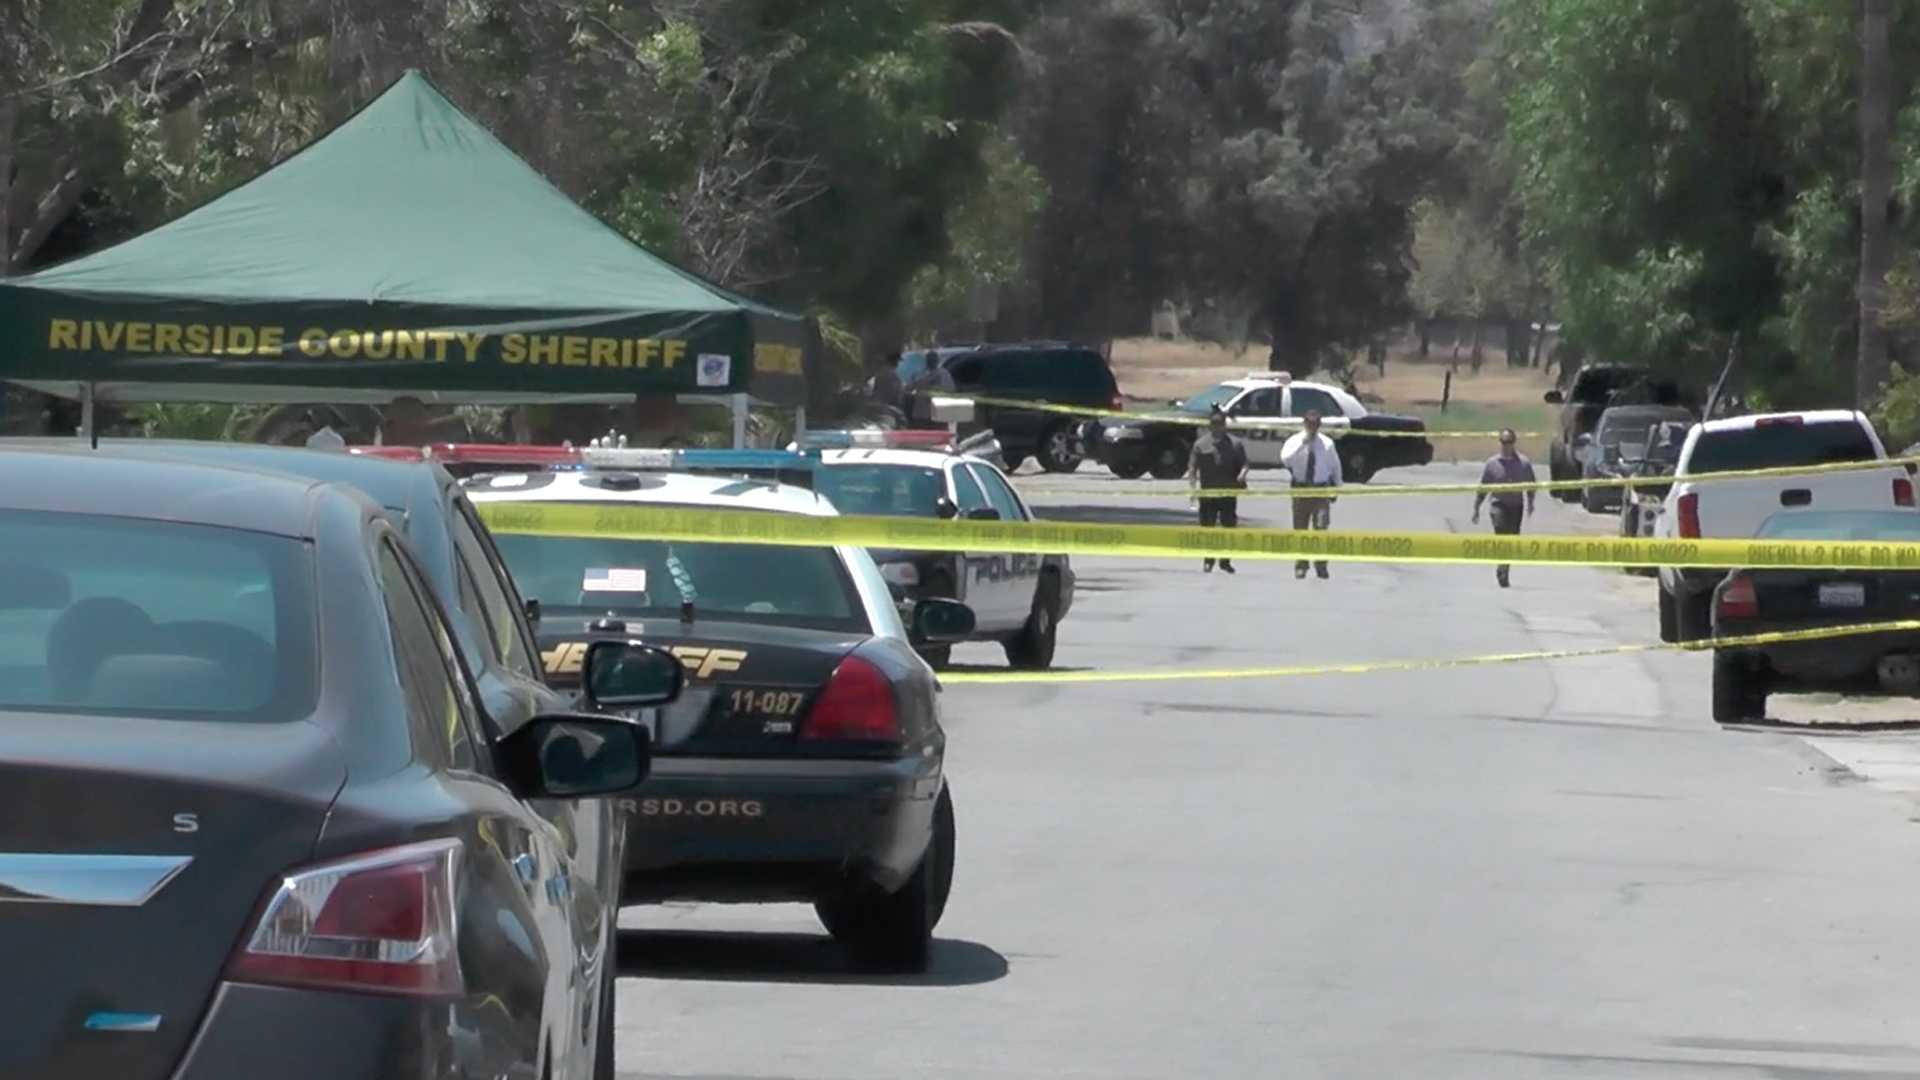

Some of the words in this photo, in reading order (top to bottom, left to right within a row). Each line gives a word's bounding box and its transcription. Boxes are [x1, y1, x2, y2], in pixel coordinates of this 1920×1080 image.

[48, 318, 285, 356] RIVERSIDE
[299, 328, 485, 363] COUNTY
[500, 333, 687, 368] SHERIFF
[730, 689, 804, 713] 11-087
[173, 813, 198, 832] S
